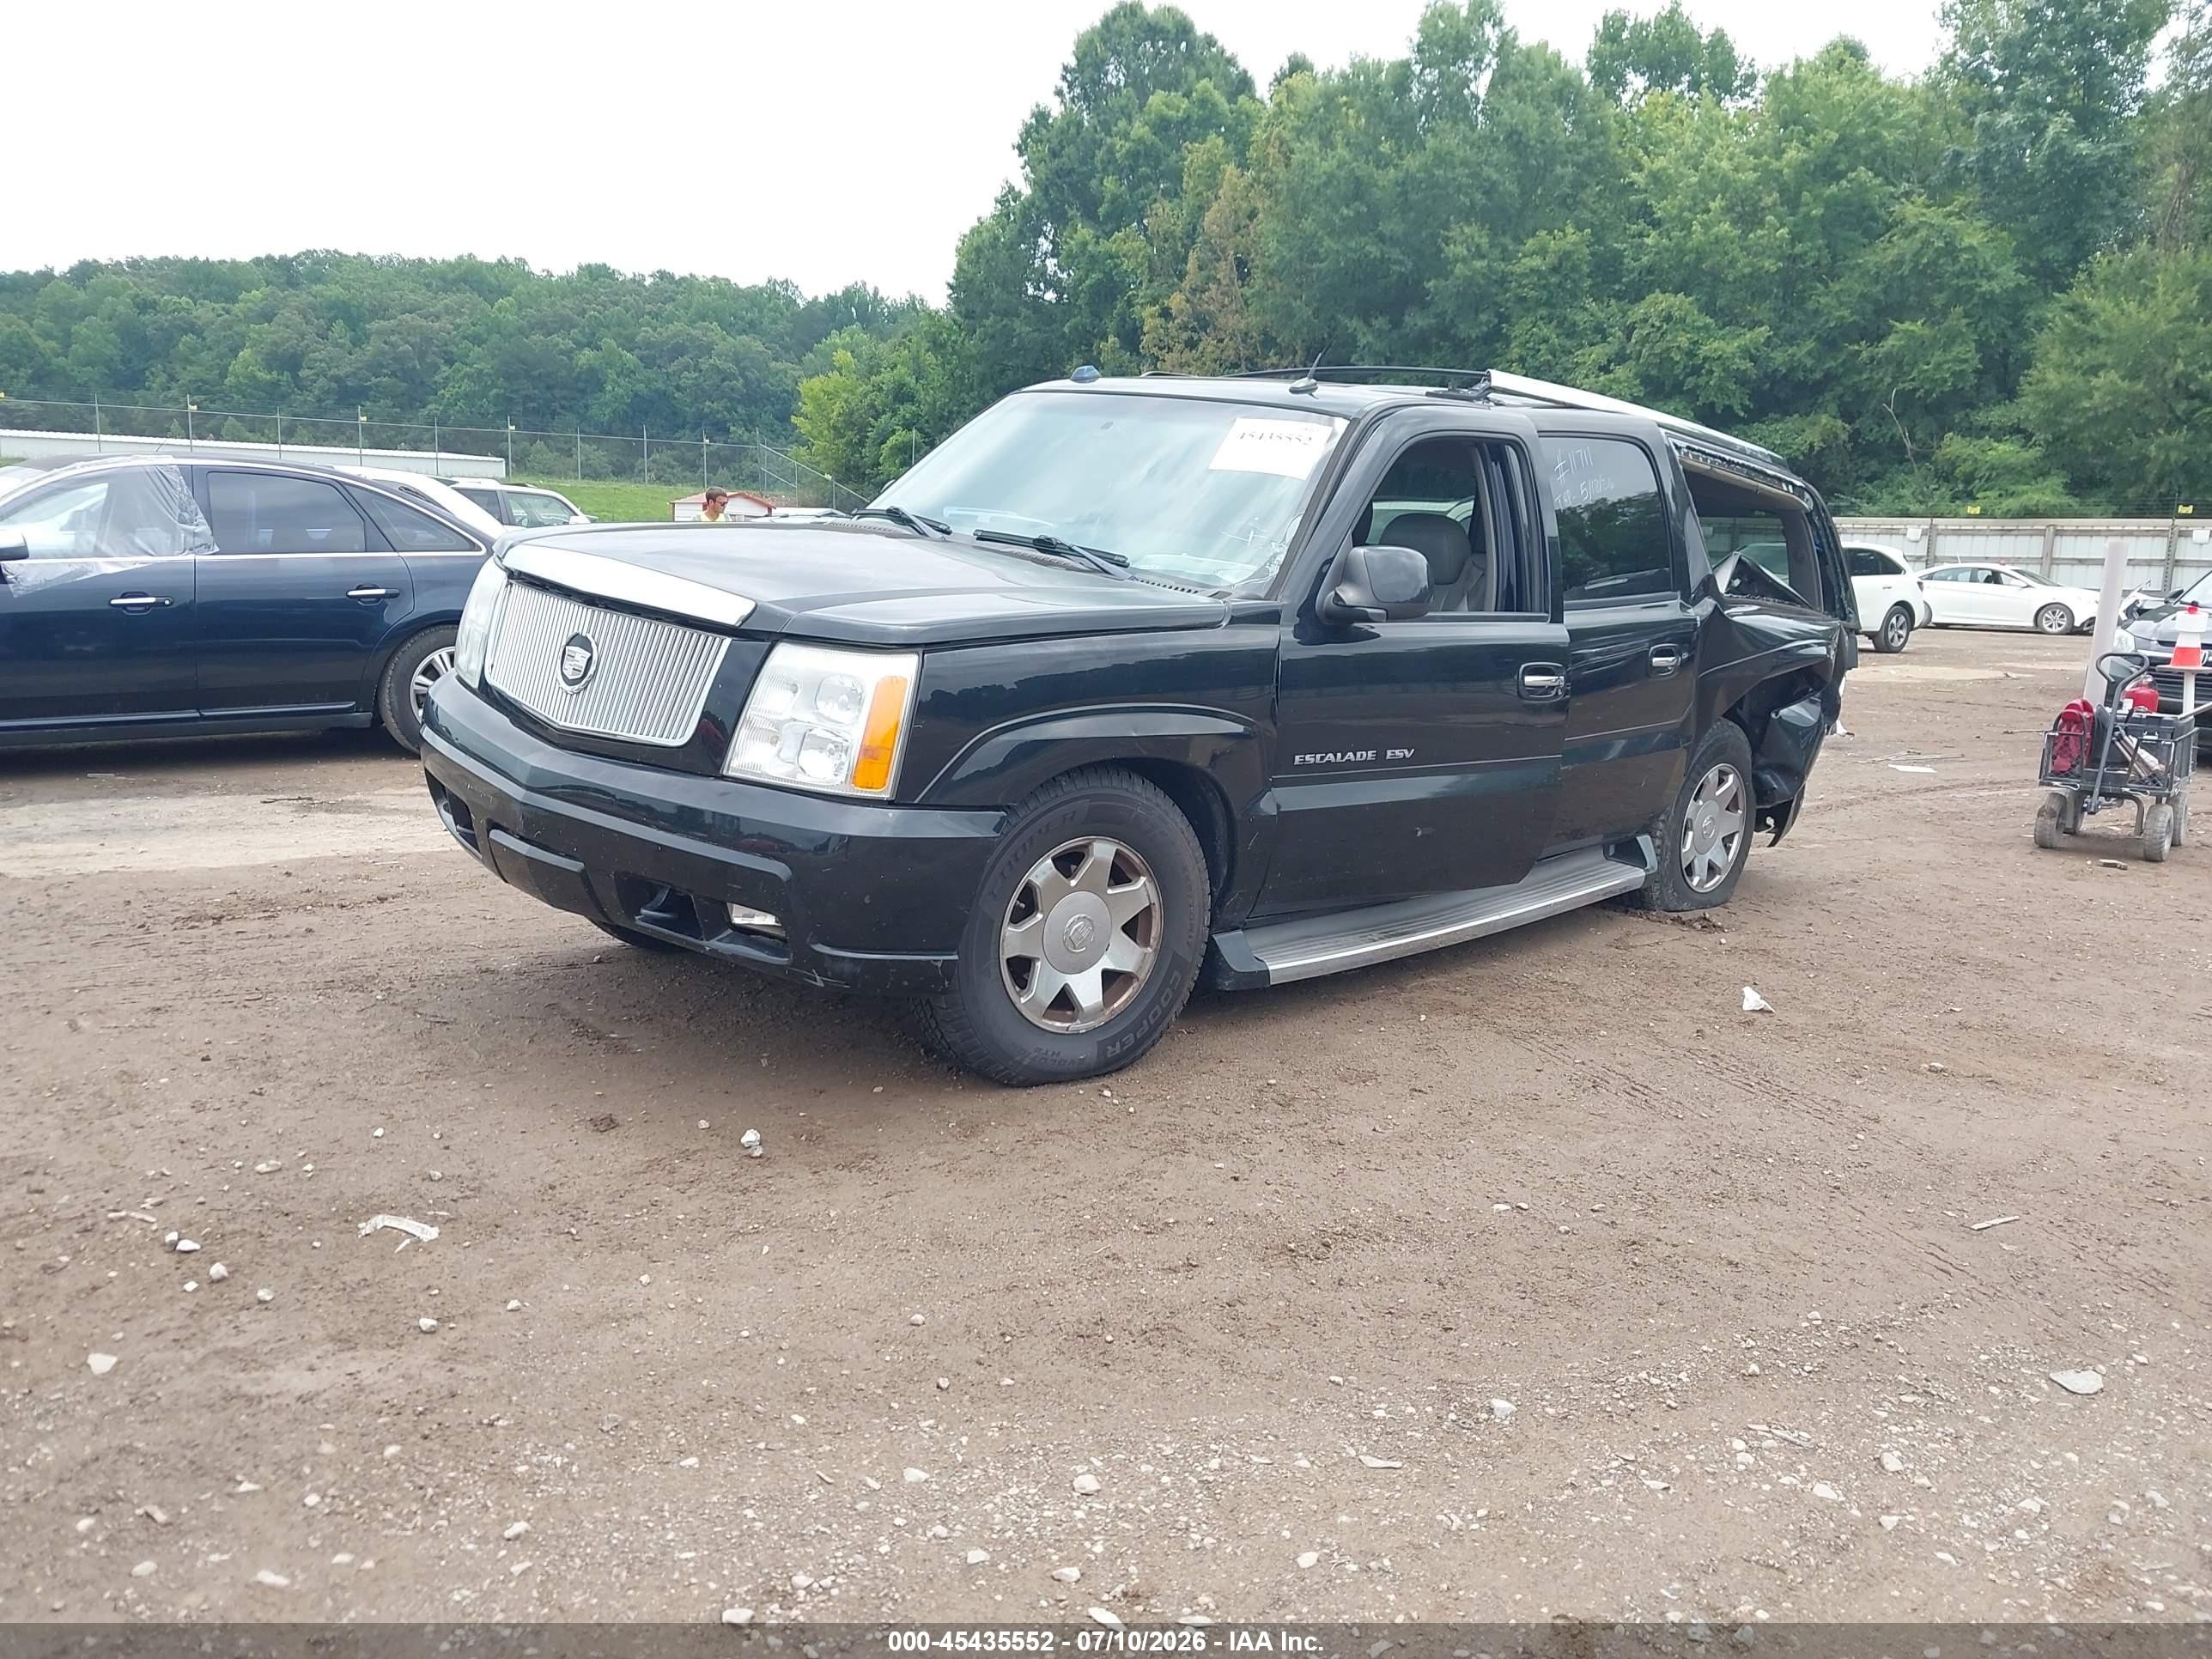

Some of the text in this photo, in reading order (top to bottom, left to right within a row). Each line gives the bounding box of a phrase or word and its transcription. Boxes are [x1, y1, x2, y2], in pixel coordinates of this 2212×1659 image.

[1293, 748, 1415, 765] ESCALADE ESV
[1106, 970, 1182, 1058] COOPER
